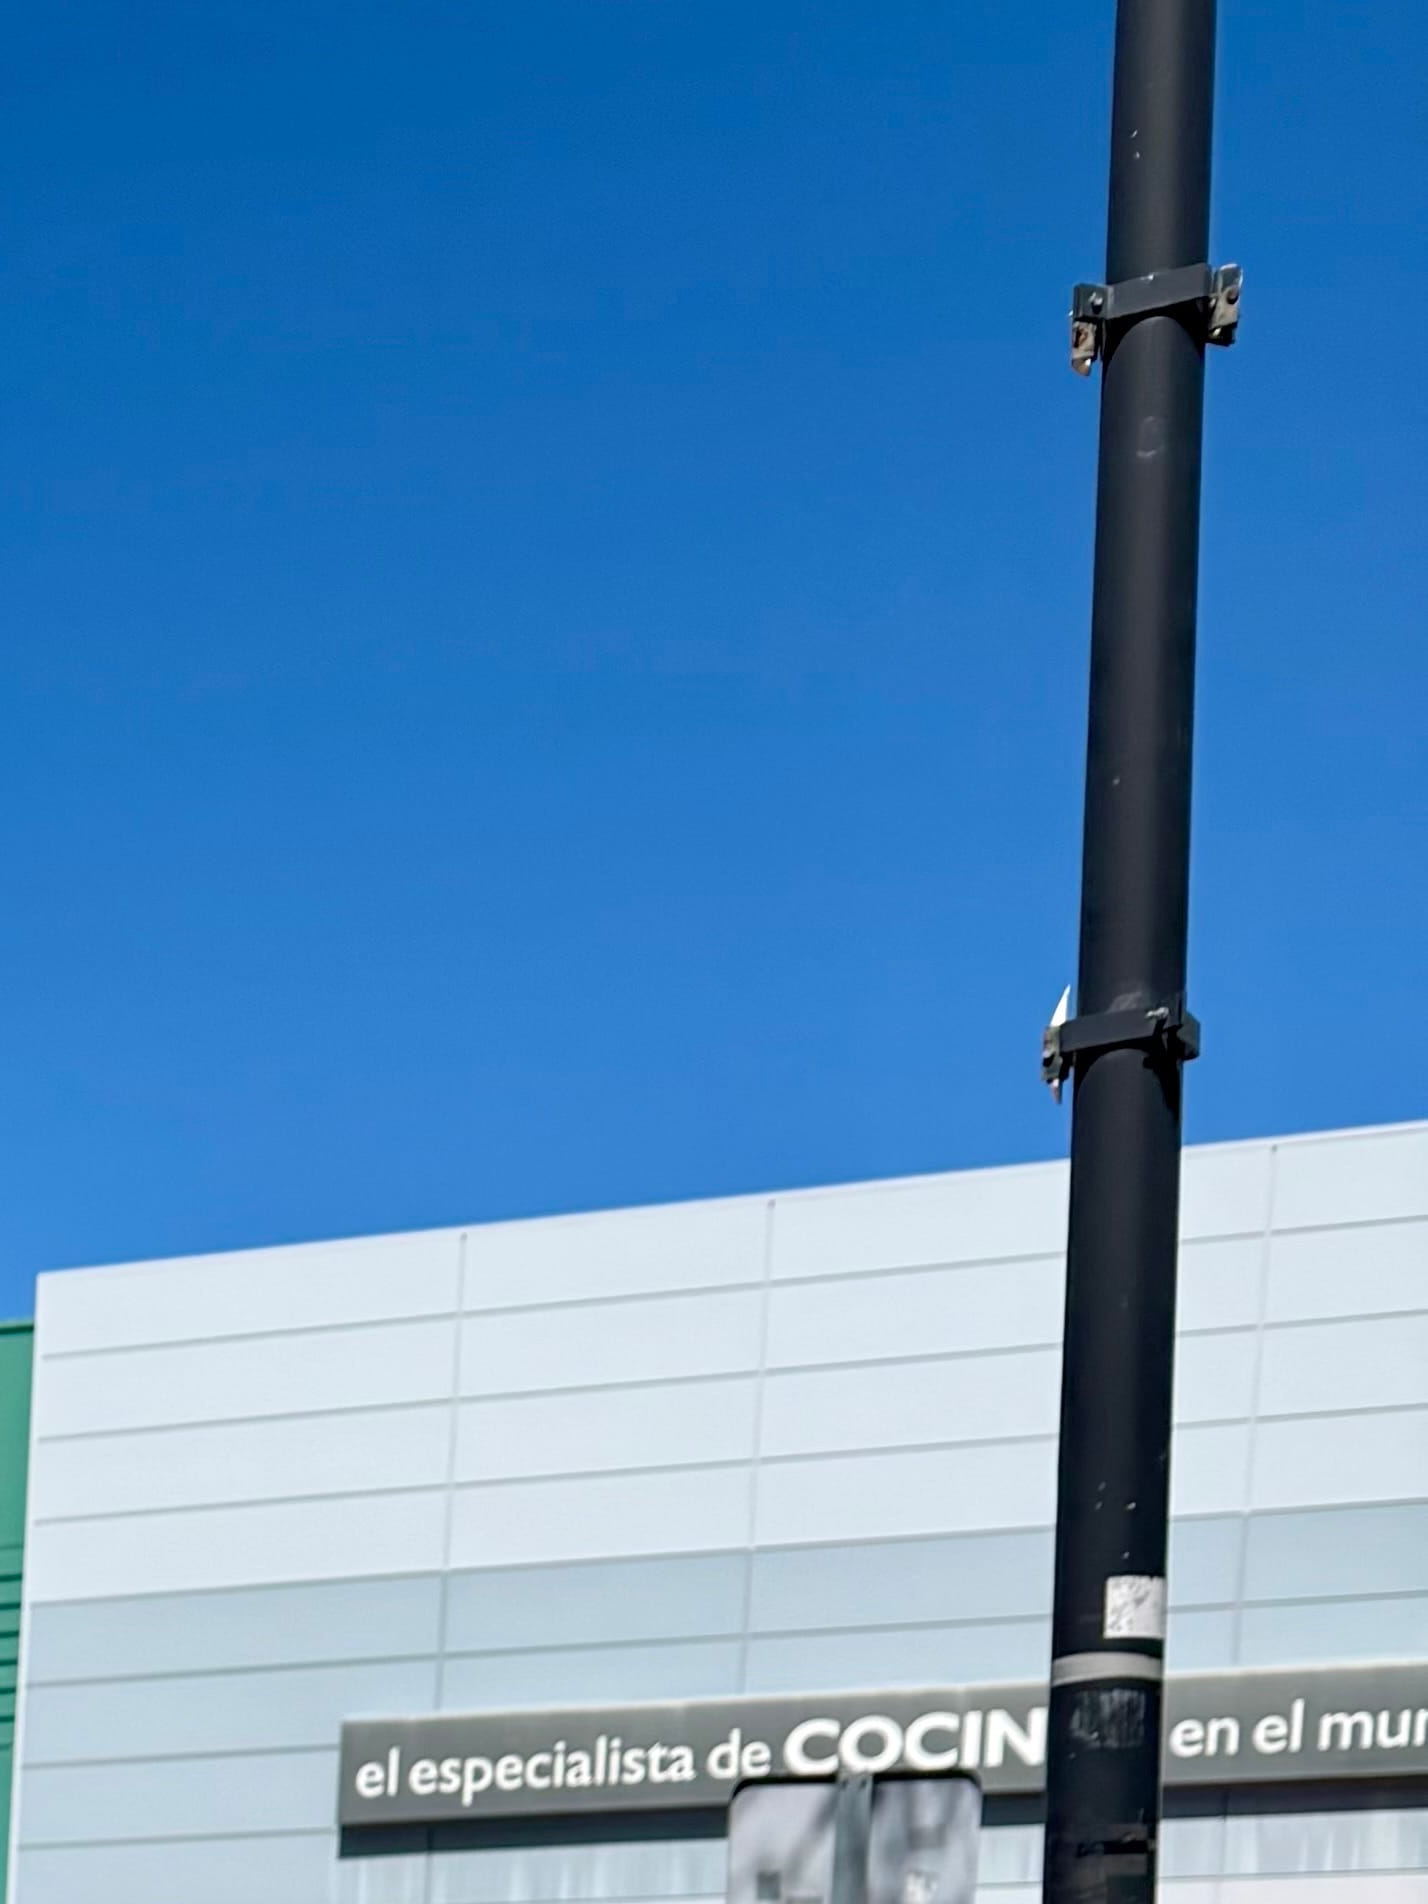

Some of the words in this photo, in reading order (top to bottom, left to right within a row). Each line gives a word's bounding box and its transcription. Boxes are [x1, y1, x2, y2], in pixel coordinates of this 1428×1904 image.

[354, 1748, 400, 1799] el
[407, 1736, 696, 1806] especialista
[708, 1729, 771, 1780] de
[782, 1707, 1049, 1776] COCIN
[1170, 1717, 1240, 1758] en
[1253, 1698, 1305, 1754] el
